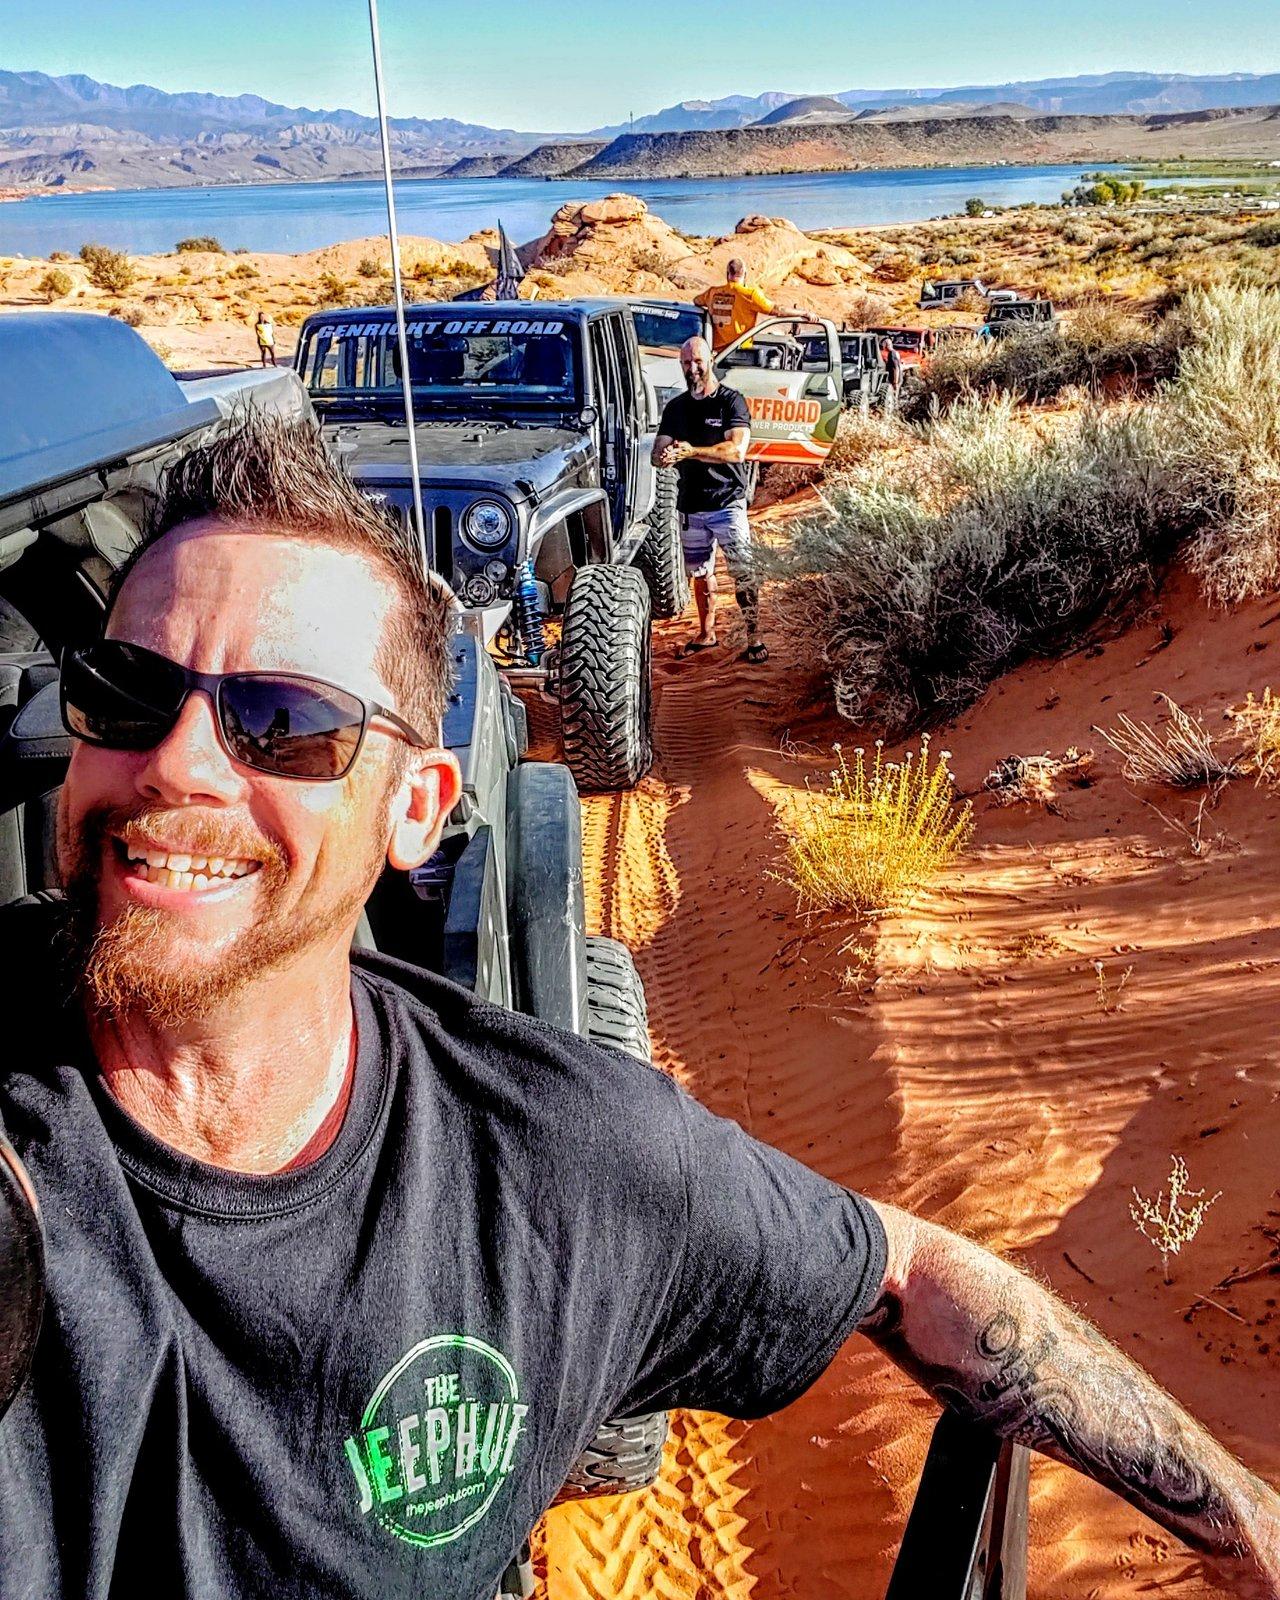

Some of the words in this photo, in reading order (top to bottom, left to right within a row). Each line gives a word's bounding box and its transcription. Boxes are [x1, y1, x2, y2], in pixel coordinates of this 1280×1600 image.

[443, 320, 491, 335] OFF
[491, 321, 564, 335] ROAD
[772, 422, 815, 434] PRODUCTS
[424, 1373, 460, 1407] THE
[343, 1399, 529, 1514] JEEPHUT
[405, 1481, 486, 1517] thejeephut.com
